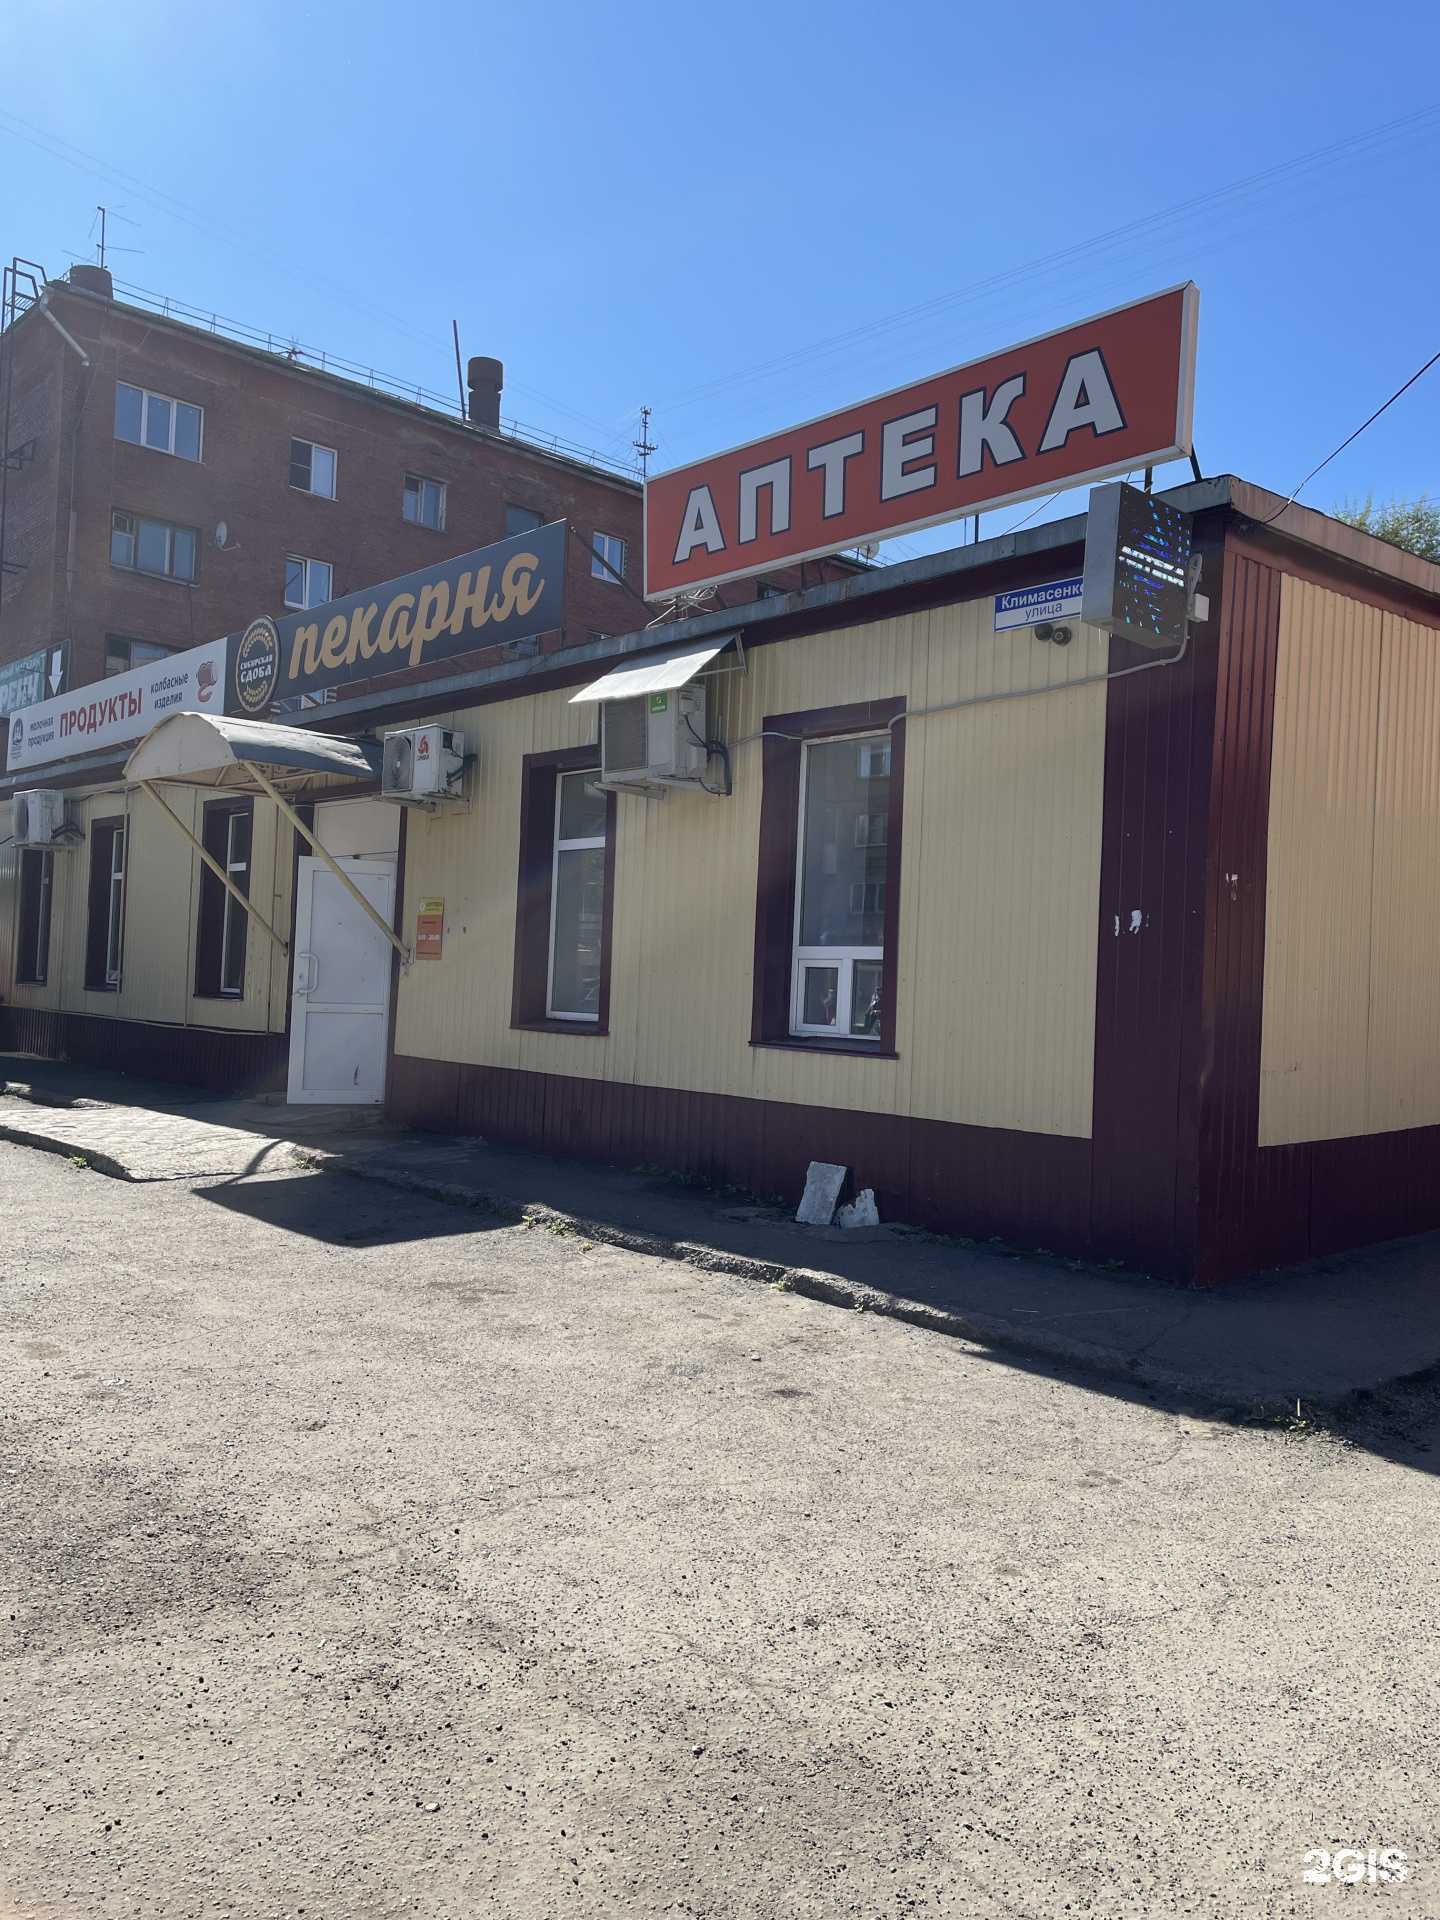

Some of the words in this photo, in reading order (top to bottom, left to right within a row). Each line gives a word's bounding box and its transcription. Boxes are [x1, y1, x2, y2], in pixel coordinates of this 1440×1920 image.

[672, 346, 1127, 565] АПТЕКА
[289, 552, 545, 679] пекарня
[1025, 600, 1063, 622] улица
[150, 671, 189, 695] колбасные
[240, 664, 272, 684] СДОБА
[153, 691, 183, 710] изделия
[59, 688, 143, 738] ПРОДУКТЫ
